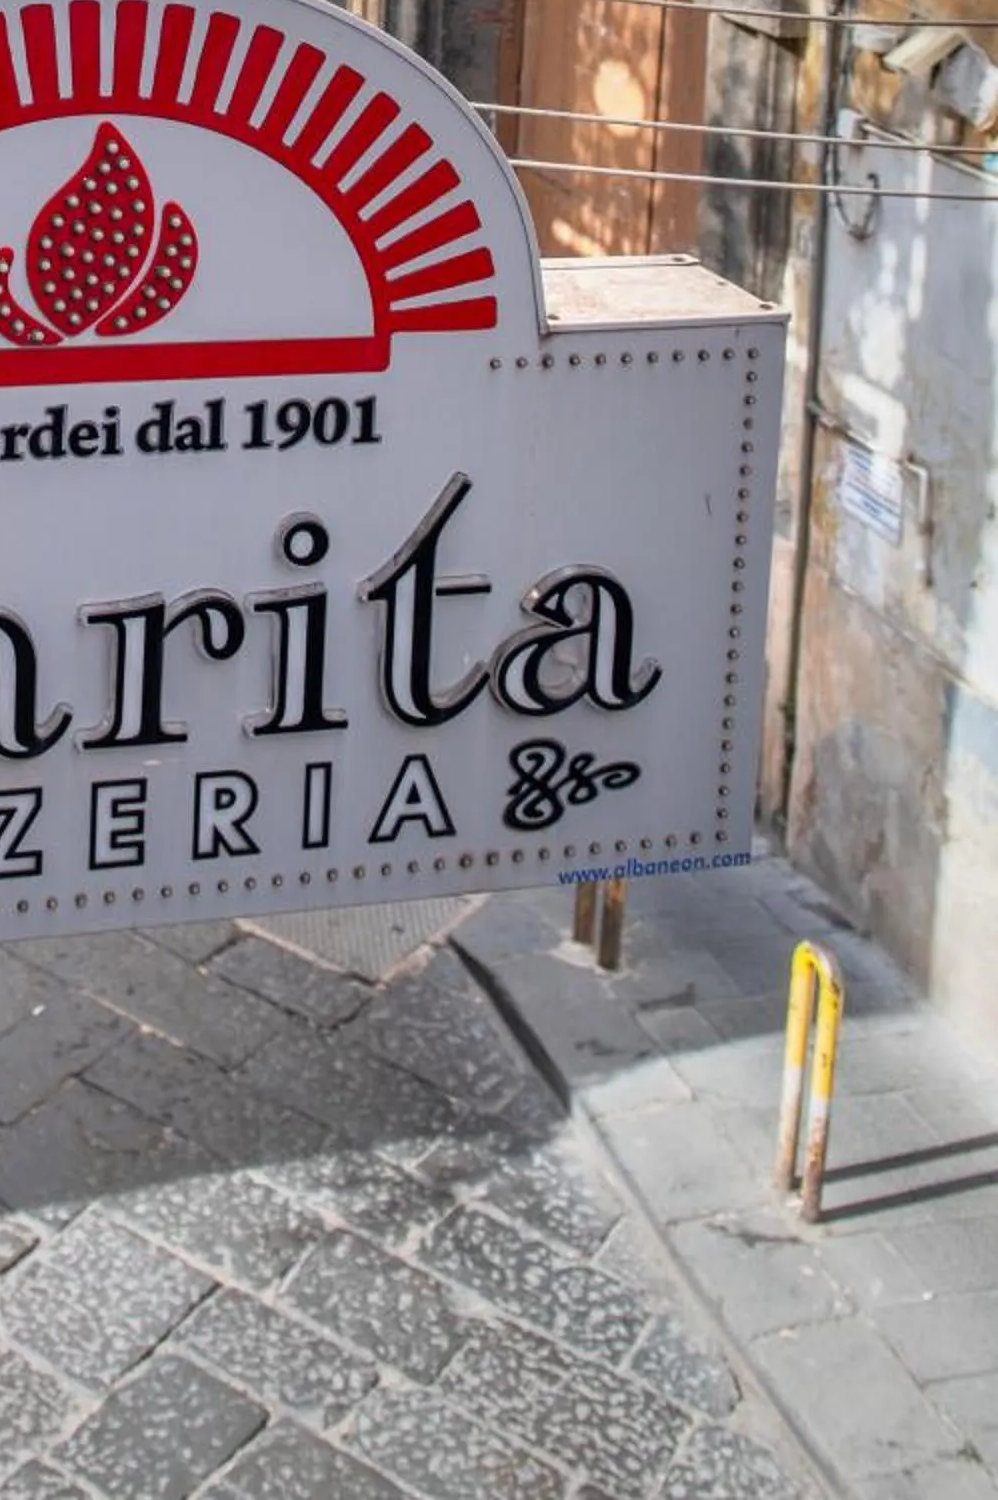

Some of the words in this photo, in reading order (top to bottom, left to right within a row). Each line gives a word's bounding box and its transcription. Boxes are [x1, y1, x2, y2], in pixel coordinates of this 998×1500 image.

[136, 398, 227, 454] dal
[244, 395, 382, 450] 1901
[558, 851, 751, 885] www.albaneon.com
